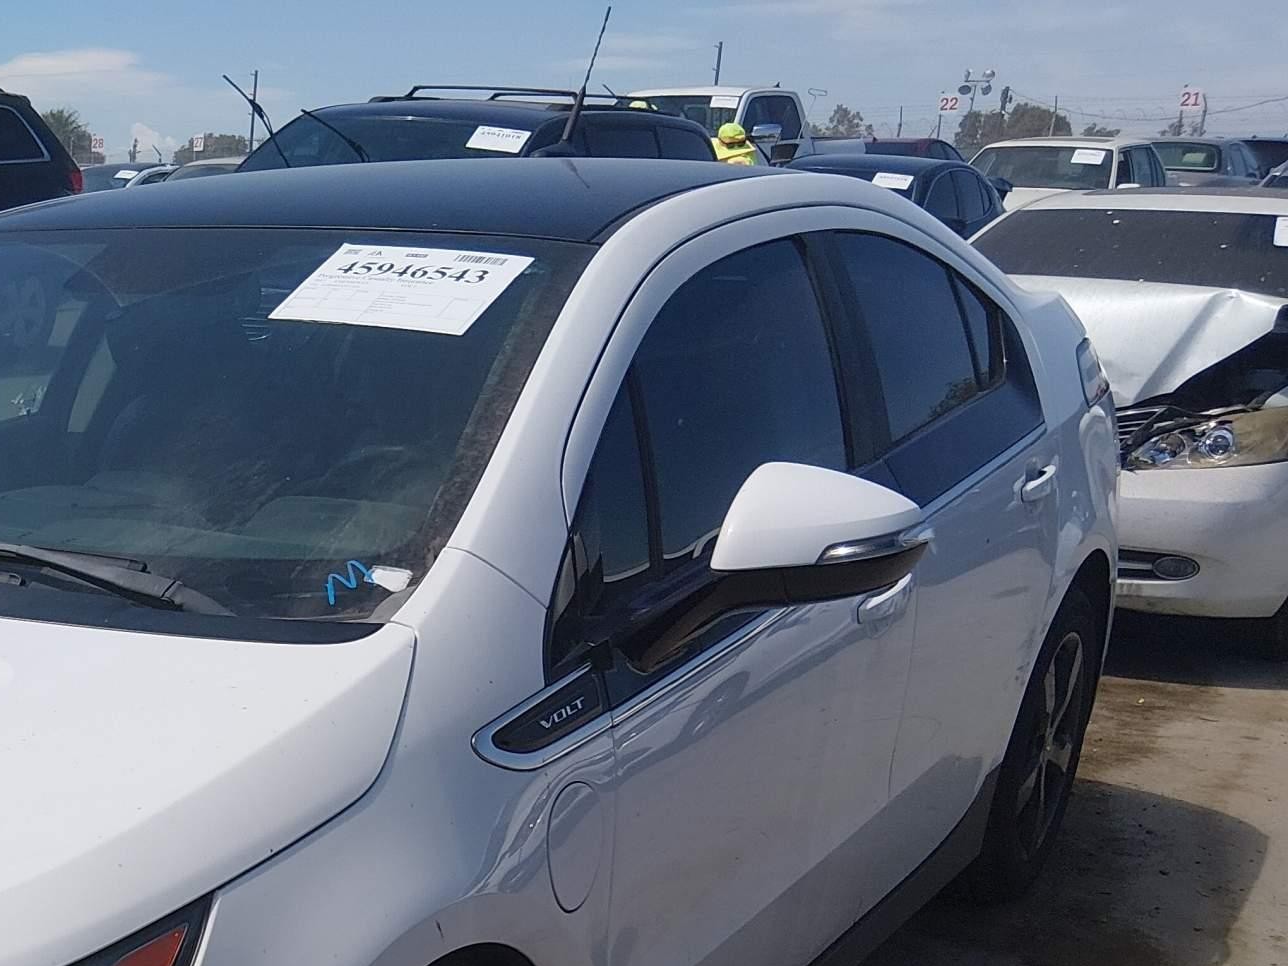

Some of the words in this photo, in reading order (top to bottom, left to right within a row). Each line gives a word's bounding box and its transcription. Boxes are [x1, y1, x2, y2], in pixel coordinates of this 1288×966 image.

[940, 97, 959, 111] 22
[1180, 91, 1200, 107] 21
[92, 138, 104, 149] 28
[337, 260, 490, 284] 45946543
[540, 696, 585, 729] VOLT
